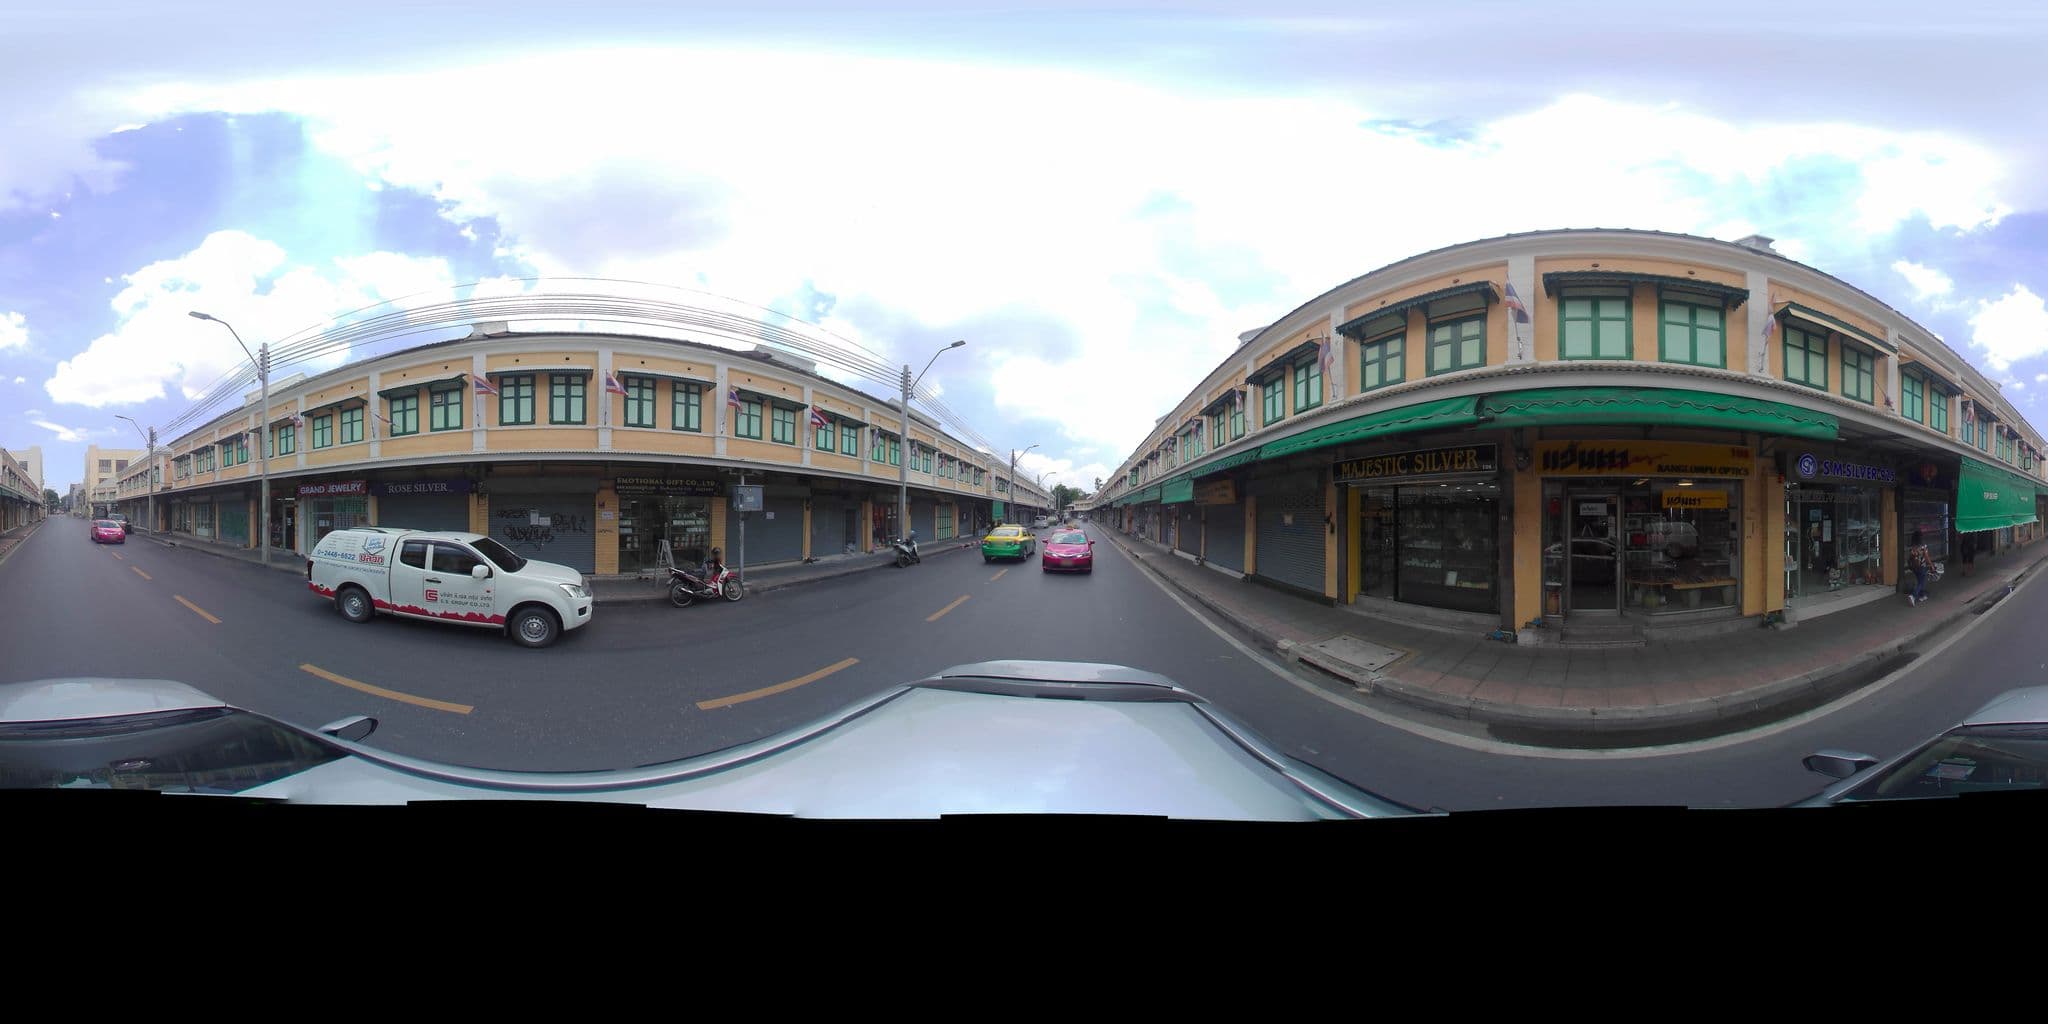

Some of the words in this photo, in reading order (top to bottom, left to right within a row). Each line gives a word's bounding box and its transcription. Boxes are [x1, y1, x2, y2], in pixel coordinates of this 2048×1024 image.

[1341, 455, 1408, 479] MAJESTIC
[1413, 448, 1479, 472] SILVER
[1719, 466, 1749, 476] OPTICS
[617, 477, 664, 485] EMOTIONAL
[300, 485, 325, 495] GRAND
[327, 482, 361, 493] JEWELRY
[388, 484, 412, 494] ROSE
[413, 482, 447, 493] SILVER
